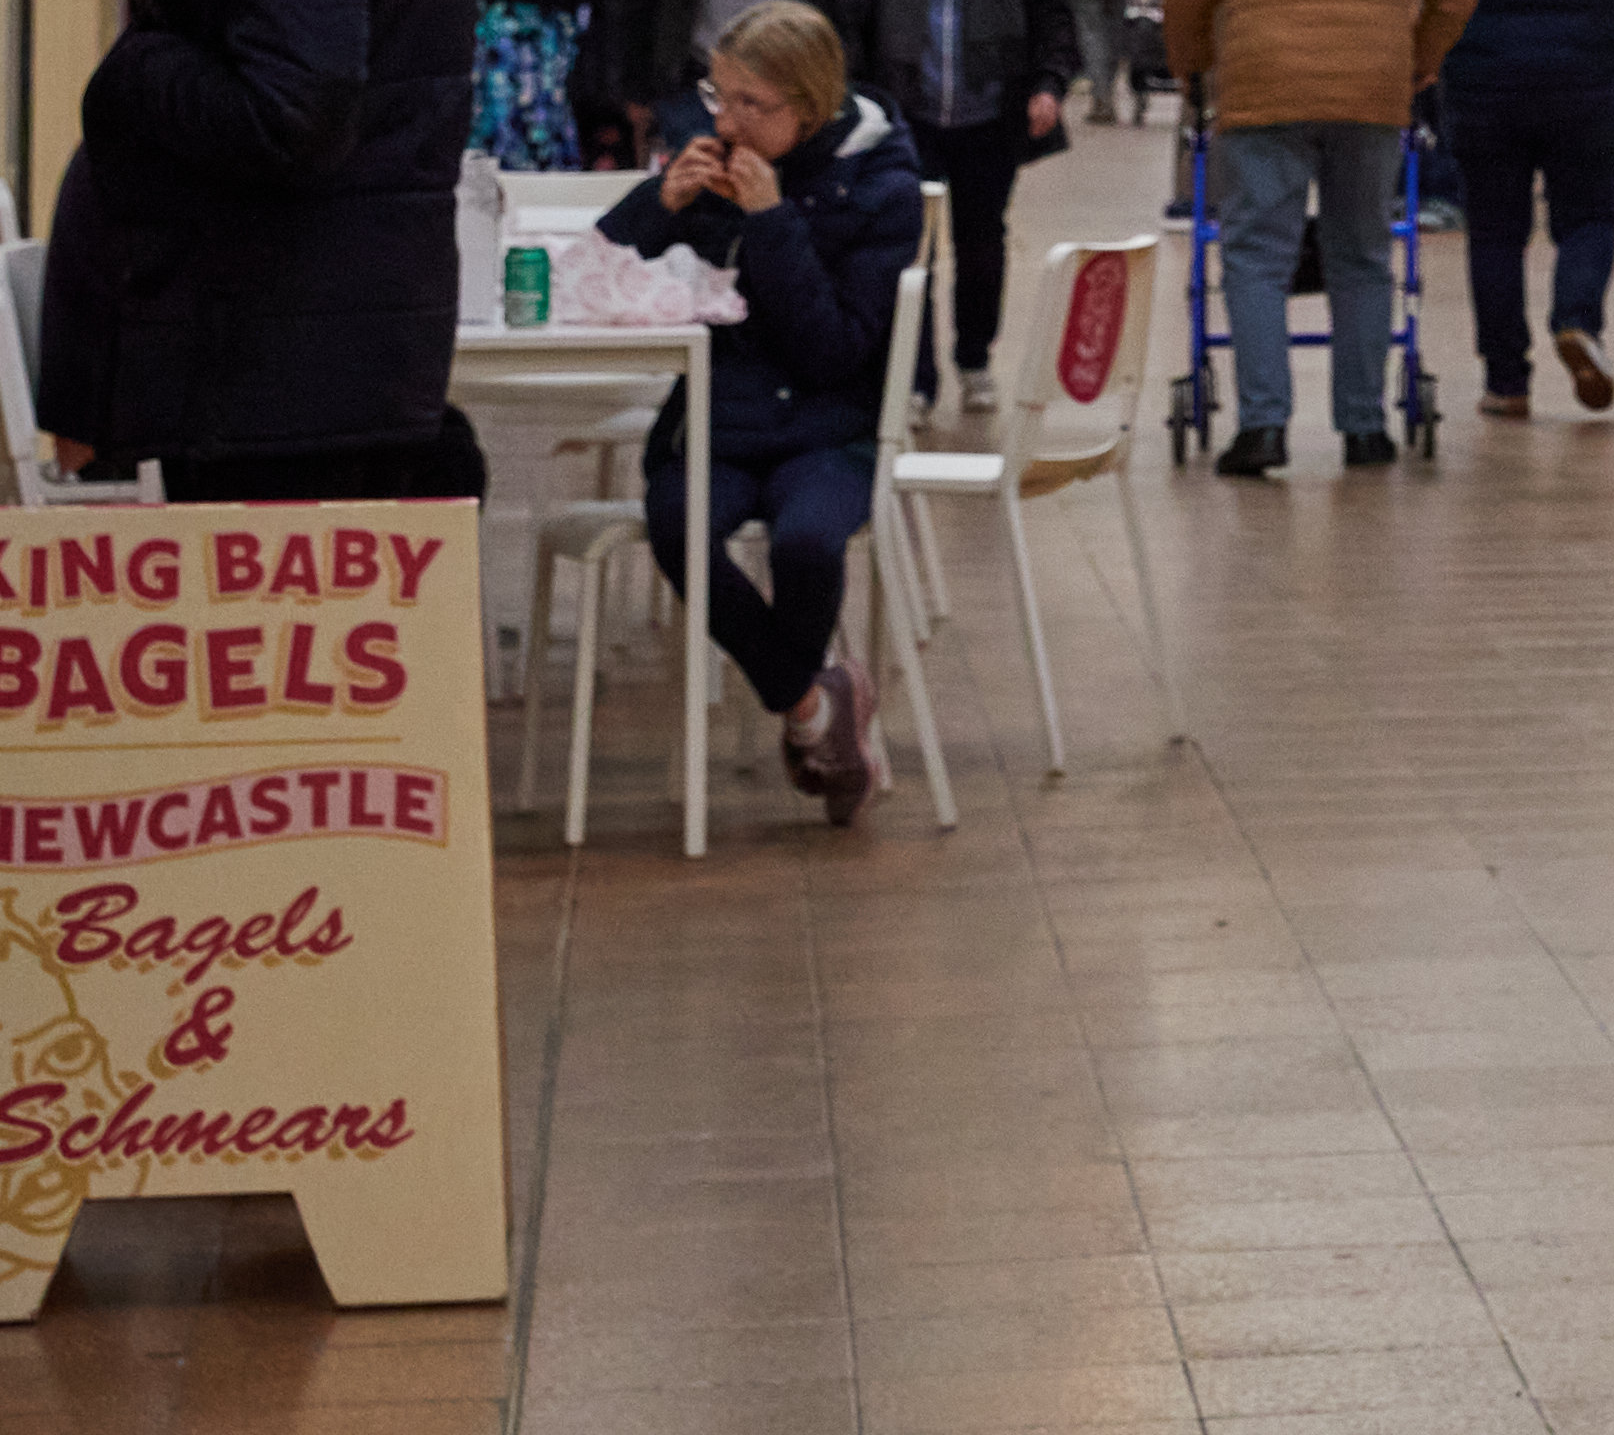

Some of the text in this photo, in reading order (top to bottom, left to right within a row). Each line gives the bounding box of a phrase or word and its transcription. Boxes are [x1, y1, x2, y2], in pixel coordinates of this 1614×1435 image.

[213, 527, 445, 600] BABY
[0, 621, 409, 720] BAGELS
[56, 882, 355, 986] Bagels
[164, 986, 236, 1067] &
[0, 1082, 416, 1164] Schmears
